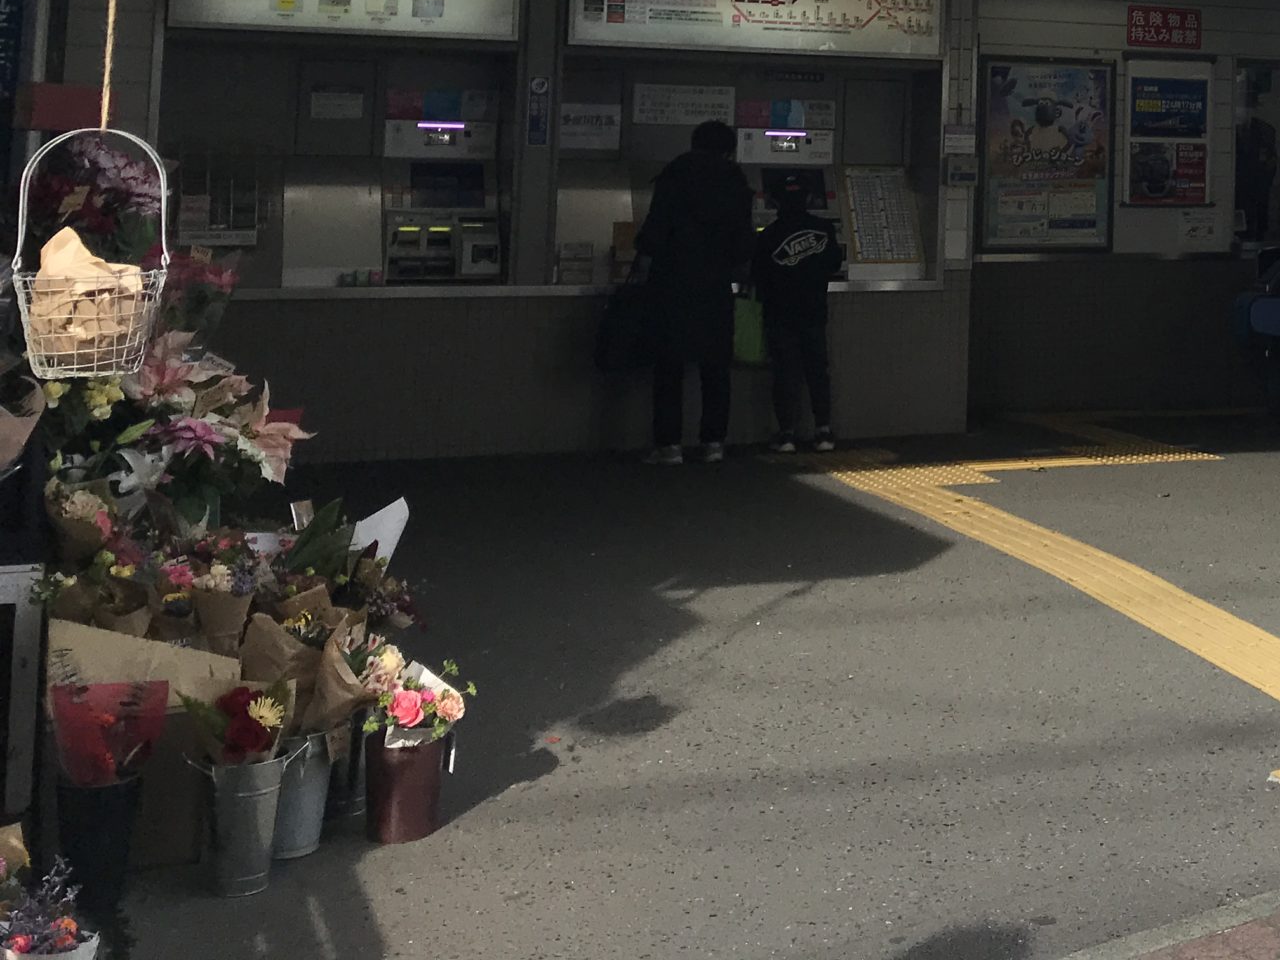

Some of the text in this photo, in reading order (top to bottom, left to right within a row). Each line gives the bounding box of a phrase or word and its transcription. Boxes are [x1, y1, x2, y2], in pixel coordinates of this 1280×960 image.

[1131, 9, 1198, 28] 危険物品
[1130, 27, 1198, 45] 持込み厳禁
[1012, 147, 1085, 167] ひつじのショーン
[784, 233, 817, 256] VANS
